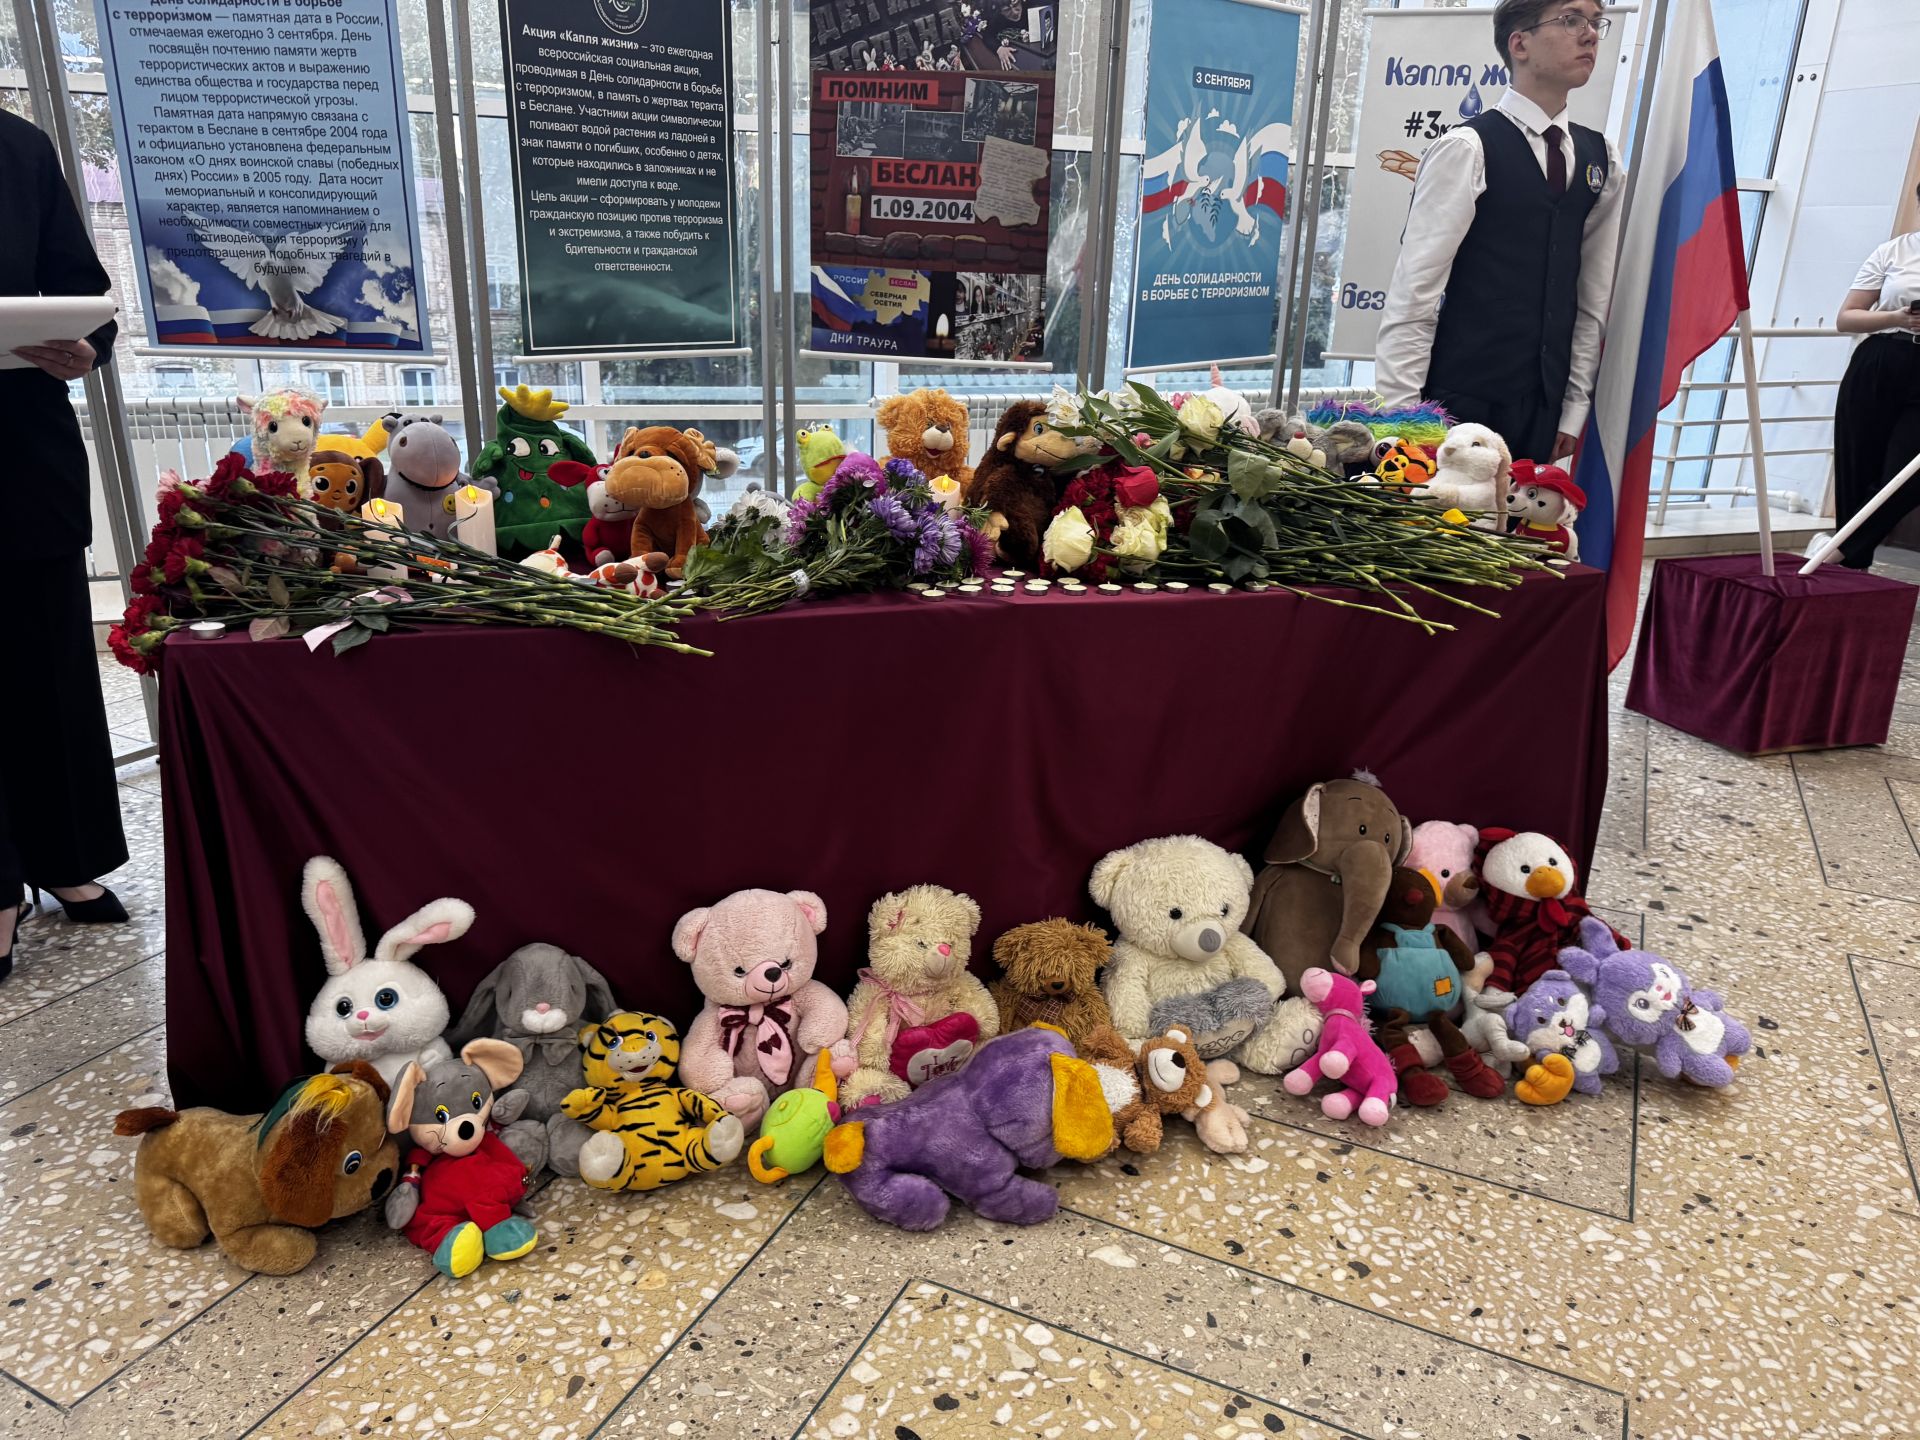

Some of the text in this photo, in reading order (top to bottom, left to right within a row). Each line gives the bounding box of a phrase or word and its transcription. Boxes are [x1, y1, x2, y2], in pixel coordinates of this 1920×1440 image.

[112, 9, 120, 19] с
[231, 12, 290, 23] памятная
[293, 13, 322, 25] дата
[324, 14, 332, 24] в
[335, 11, 383, 27] России,
[128, 26, 371, 43] отмечаемая ежегодно 3 сентября. День
[521, 23, 713, 60] Акция «Капля жизни» это ежегодная
[148, 42, 357, 60] посвящён почтению памяти жертв
[138, 59, 370, 76] террористических актов и выражению
[538, 47, 701, 77] всероссийская социальная акция,
[515, 62, 722, 95] проводимая День солидарности борьбе
[1385, 57, 1472, 86] Капля
[134, 74, 379, 93] единства общества и государства перед
[829, 80, 929, 100] ПОМНИМ
[1195, 72, 1251, 90] 3 СЕНТЯБРЯ
[160, 92, 358, 108] лицом террористической угрозы.
[523, 82, 724, 111] терроризмом, память жертвах теракта
[153, 105, 368, 123] Памятная дата напрямую связана с
[528, 98, 722, 128] Беслане. Участники акции символически
[136, 122, 388, 140] терактом в Беслане в сентябре 2004 года
[529, 119, 708, 143] поливают водой растения из ладоней
[137, 137, 391, 156] и официально установлена федеральным
[520, 137, 723, 162] знак памяти погибших, особенно детях,
[133, 154, 184, 165] законом
[208, 156, 237, 168] днях
[239, 155, 293, 168] воинской
[296, 158, 333, 168] славы
[336, 156, 399, 172] (победных
[532, 156, 716, 176] которые находились заложниках не
[154, 168, 383, 186] днях) России» в 2005 году. Дата носит
[576, 176, 680, 191] имели доступа воде.
[877, 162, 977, 188] БЕСЛАН
[164, 186, 377, 203] мемориальный и консолидирующий
[530, 189, 720, 209] Цель акции сформировать молодежи
[165, 202, 380, 216] характер, является напоминанием о
[529, 209, 723, 226] гражданскую позицию против терроризма
[873, 198, 973, 221] 1.09.2004
[159, 216, 391, 233] необходимости совместных усилий для
[186, 232, 358, 248] противодействия терроризму
[557, 227, 703, 242] экстремизма, также побудить
[270, 249, 325, 261] подобных
[329, 251, 381, 262] трагедий
[564, 242, 697, 257] бдительности гражданской
[253, 261, 309, 276] будущем.
[593, 262, 673, 271] ответственности.
[891, 279, 916, 288] БЕСЛАН
[1153, 272, 1262, 286] ДЕНЬ СОЛИДАРНОСТИ
[870, 290, 907, 301] СЕВЕРНАЯ
[1142, 286, 1270, 301] В БОРЬБЕ С ТЕРРОРИЗМОМ
[874, 299, 903, 308] ОСЕТИЯ
[830, 333, 898, 350] ДНИ ТРАУРА
